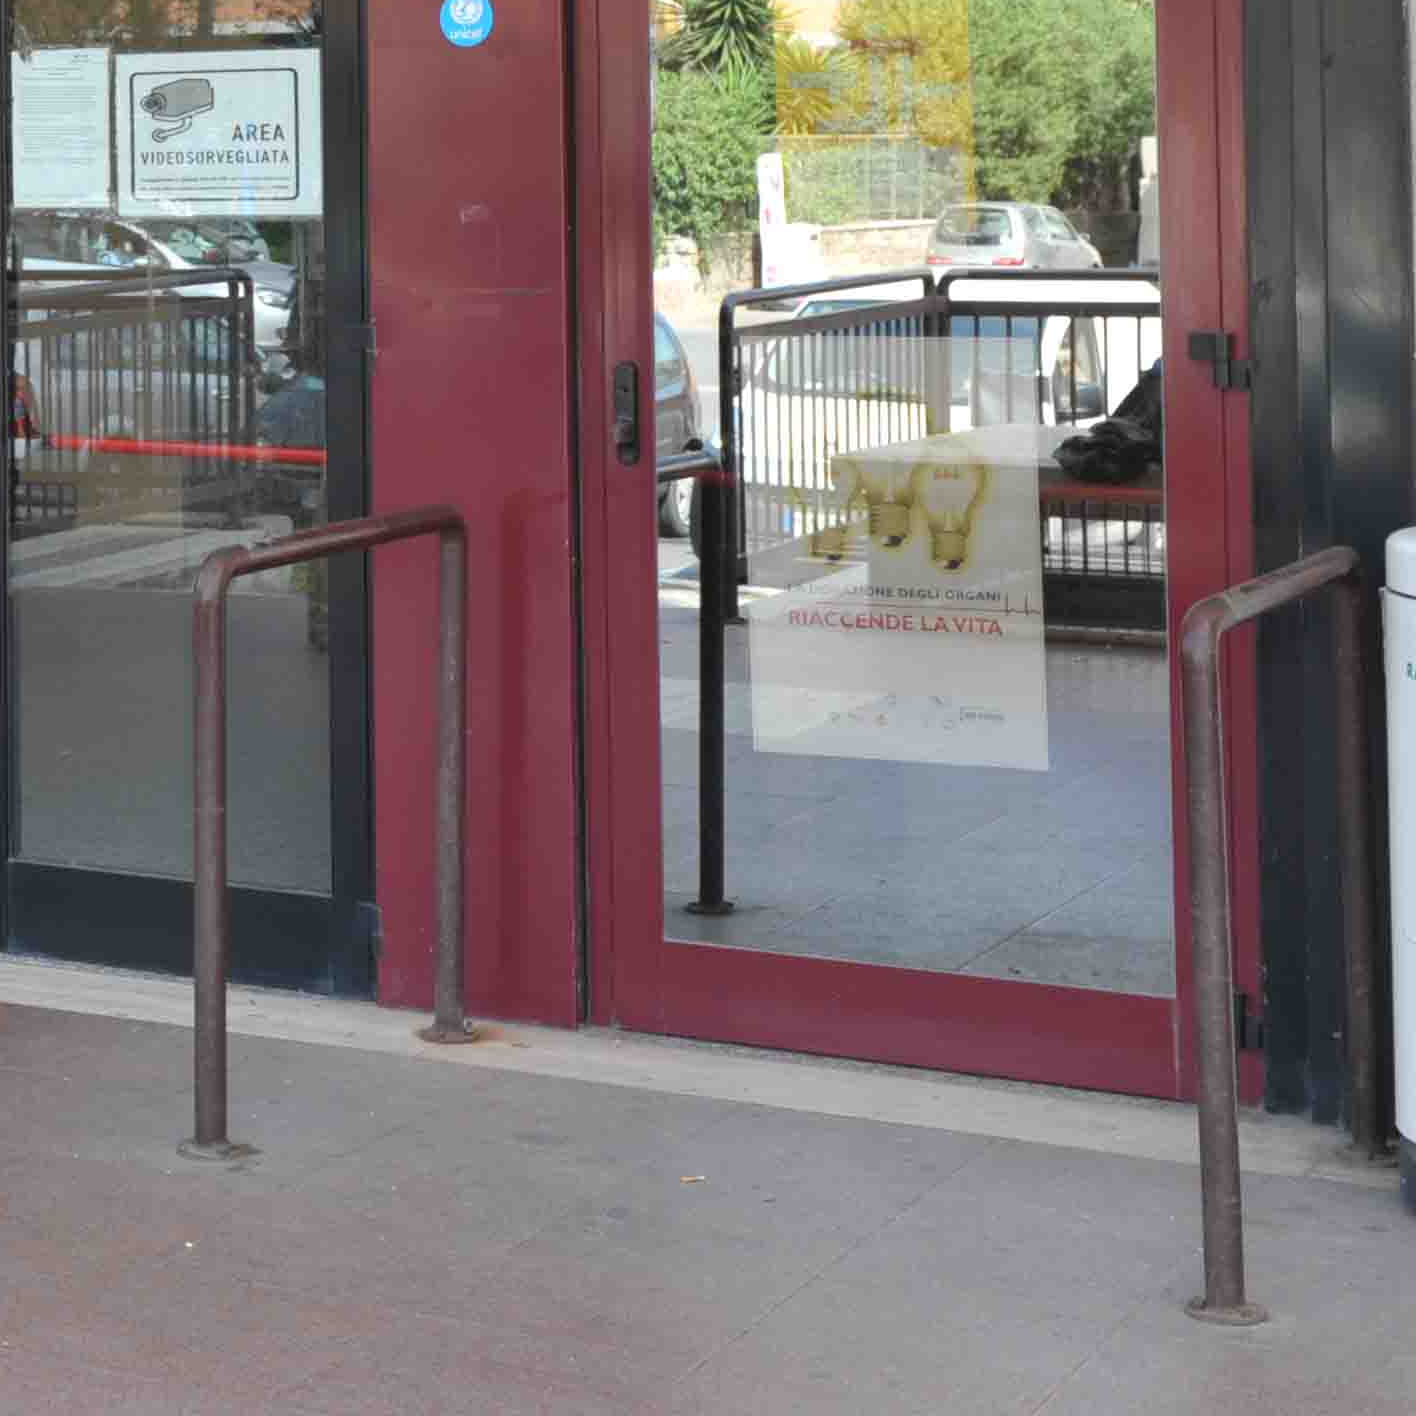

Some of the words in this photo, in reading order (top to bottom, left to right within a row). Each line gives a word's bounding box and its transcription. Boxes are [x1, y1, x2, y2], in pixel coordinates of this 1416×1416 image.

[232, 121, 285, 142] AREA
[140, 149, 289, 166] VIDEOSORVEGLIATA
[789, 610, 913, 632] RIACCENDE
[920, 615, 950, 632] LA
[952, 617, 1003, 635] VITA
